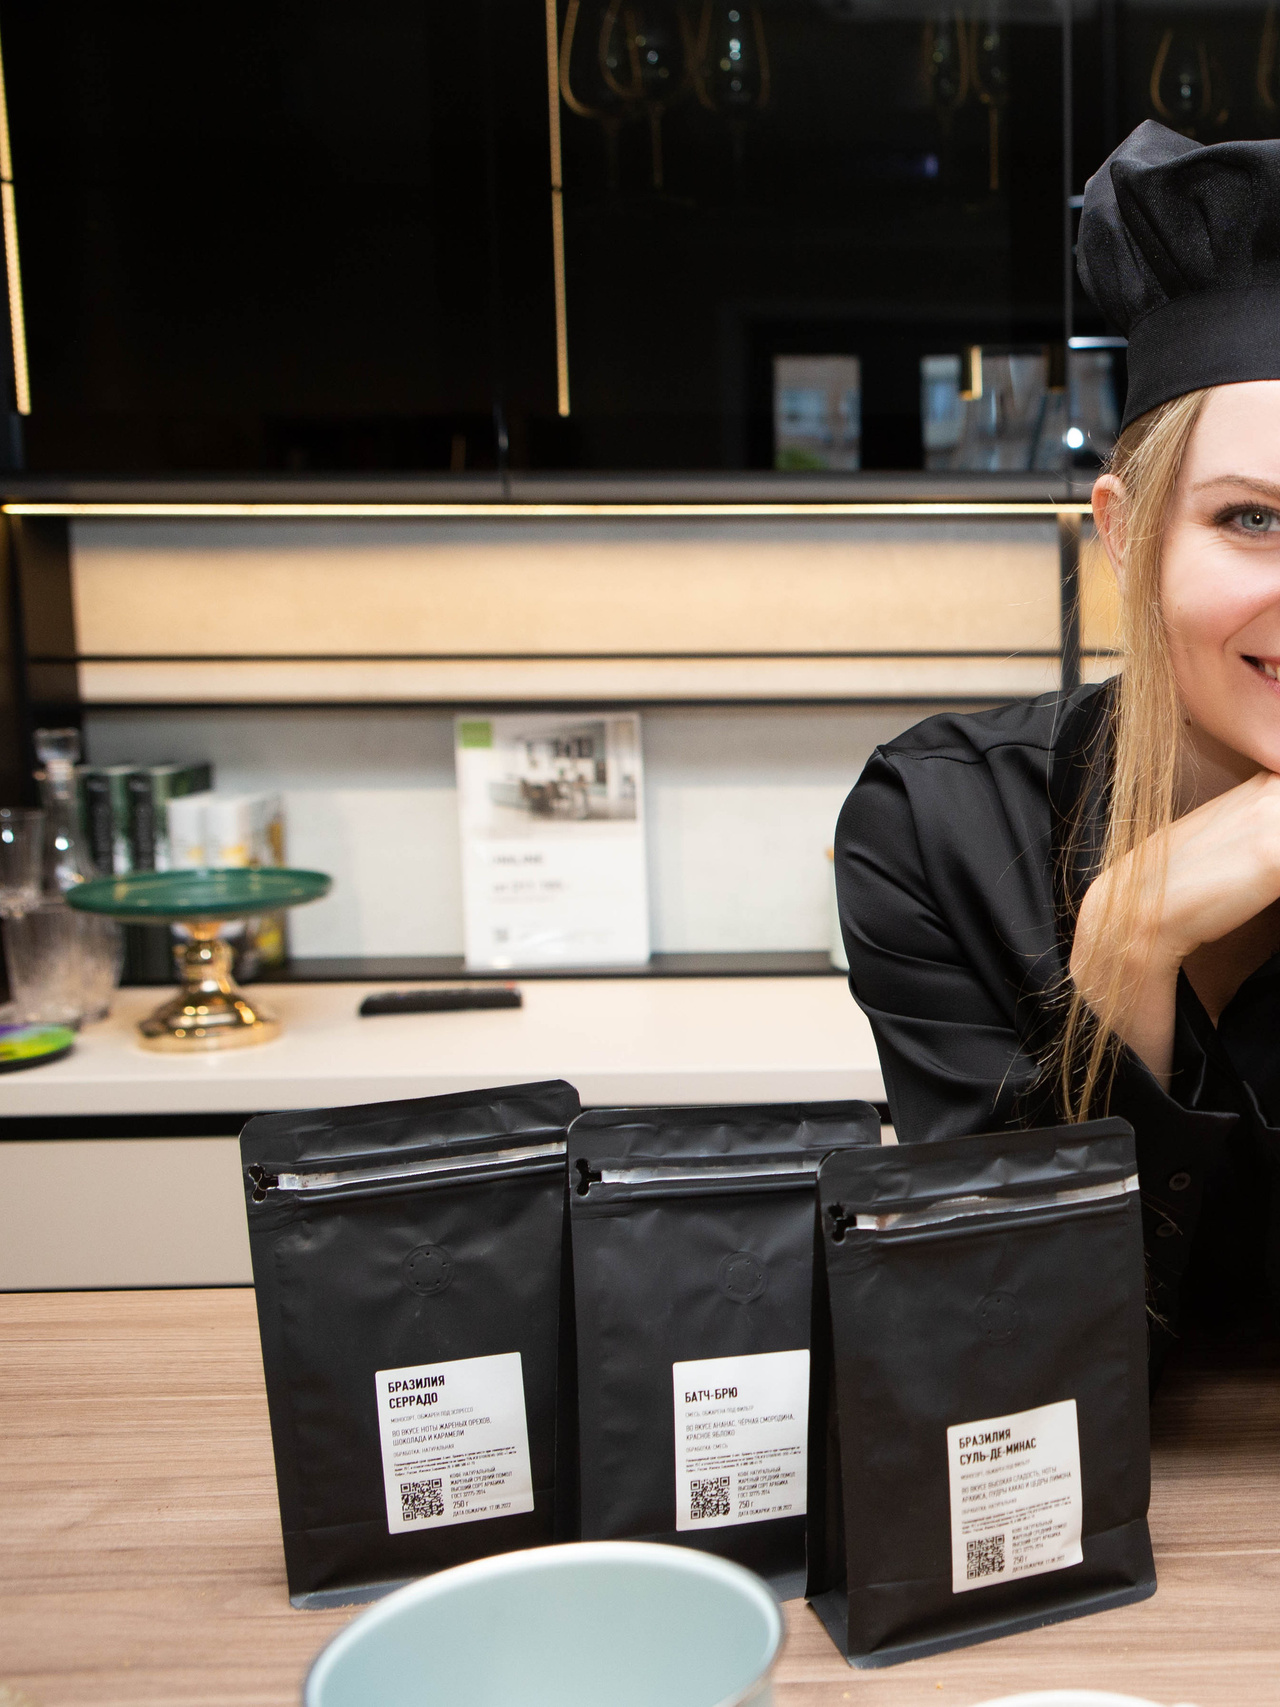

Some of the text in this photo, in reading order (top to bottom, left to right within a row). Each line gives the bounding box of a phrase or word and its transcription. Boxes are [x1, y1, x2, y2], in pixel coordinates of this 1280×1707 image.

[388, 1375, 445, 1393] БРАЗИЛИЯ
[389, 1393, 438, 1409] СЕРРАДО
[685, 1387, 738, 1403] БАТЧ-БРЮ
[401, 1427, 419, 1436] ВКУСЕ
[421, 1425, 438, 1433] НОТЫ
[439, 1421, 467, 1430] ЖАРЕНЫХ
[468, 1417, 492, 1426] ОРЕХОВ,
[393, 1436, 427, 1446] ШОКОЛАДА
[434, 1430, 464, 1439] КАРАМЕЛИ
[686, 1432, 711, 1440] КРАСНОЕ
[959, 1429, 1010, 1449] БРАЗИЛИЯ
[422, 1444, 454, 1453] НАТУРАЛЬНАЯ
[960, 1438, 1036, 1466] СУЛЬ-ДЕ-МИНАС
[453, 1500, 465, 1509] 250
[739, 1500, 750, 1508] 250
